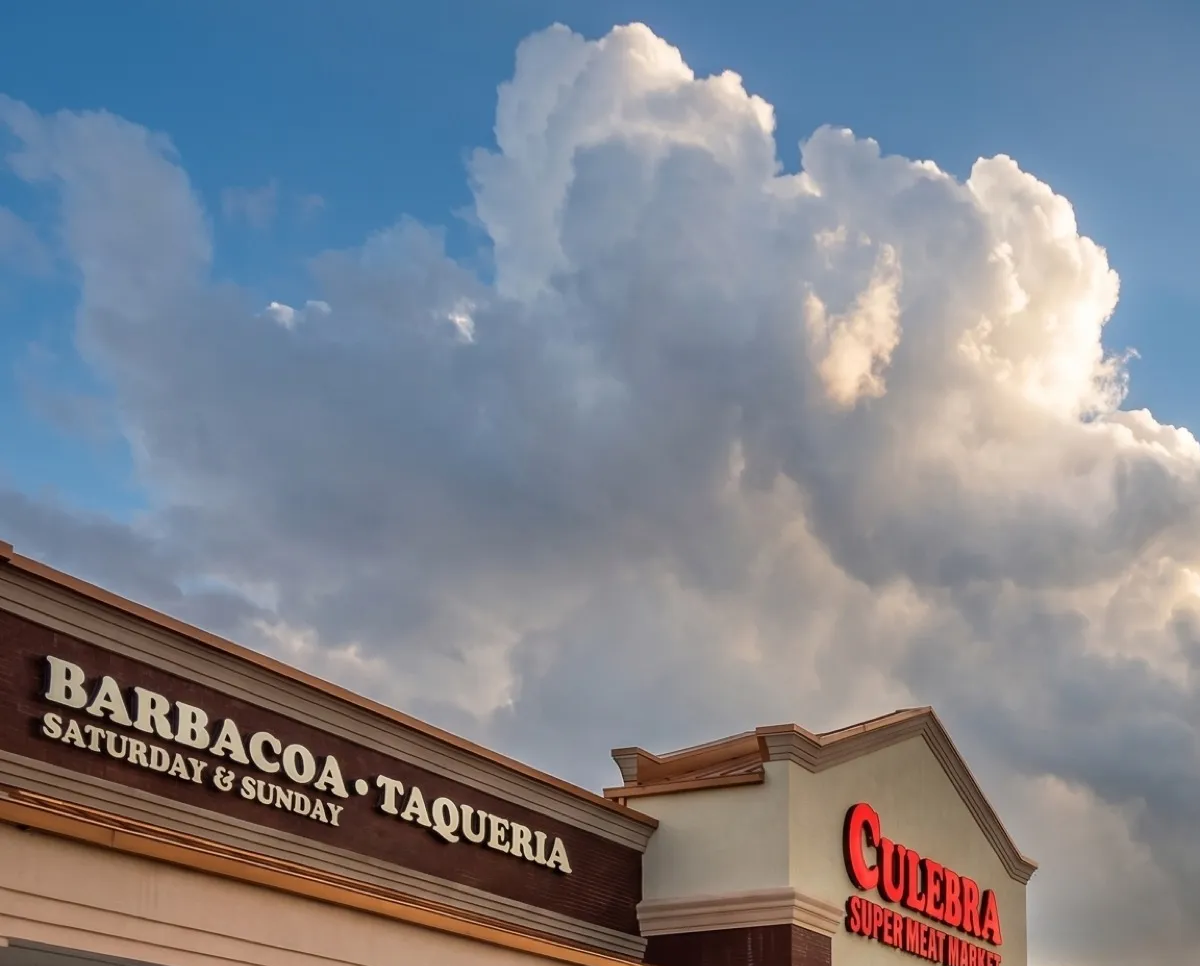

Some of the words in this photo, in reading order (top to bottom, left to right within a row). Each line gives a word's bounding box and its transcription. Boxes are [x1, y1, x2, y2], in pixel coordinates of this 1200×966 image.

[42, 712, 208, 784] SATURDAY
[213, 766, 235, 792] &
[240, 776, 344, 827] SUNDAY
[45, 655, 349, 799] BARBACOA
[376, 774, 573, 874] TAQUERIA
[844, 802, 1002, 946] CULEBRA
[847, 895, 903, 950] SUPER
[904, 916, 946, 963] MEAT
